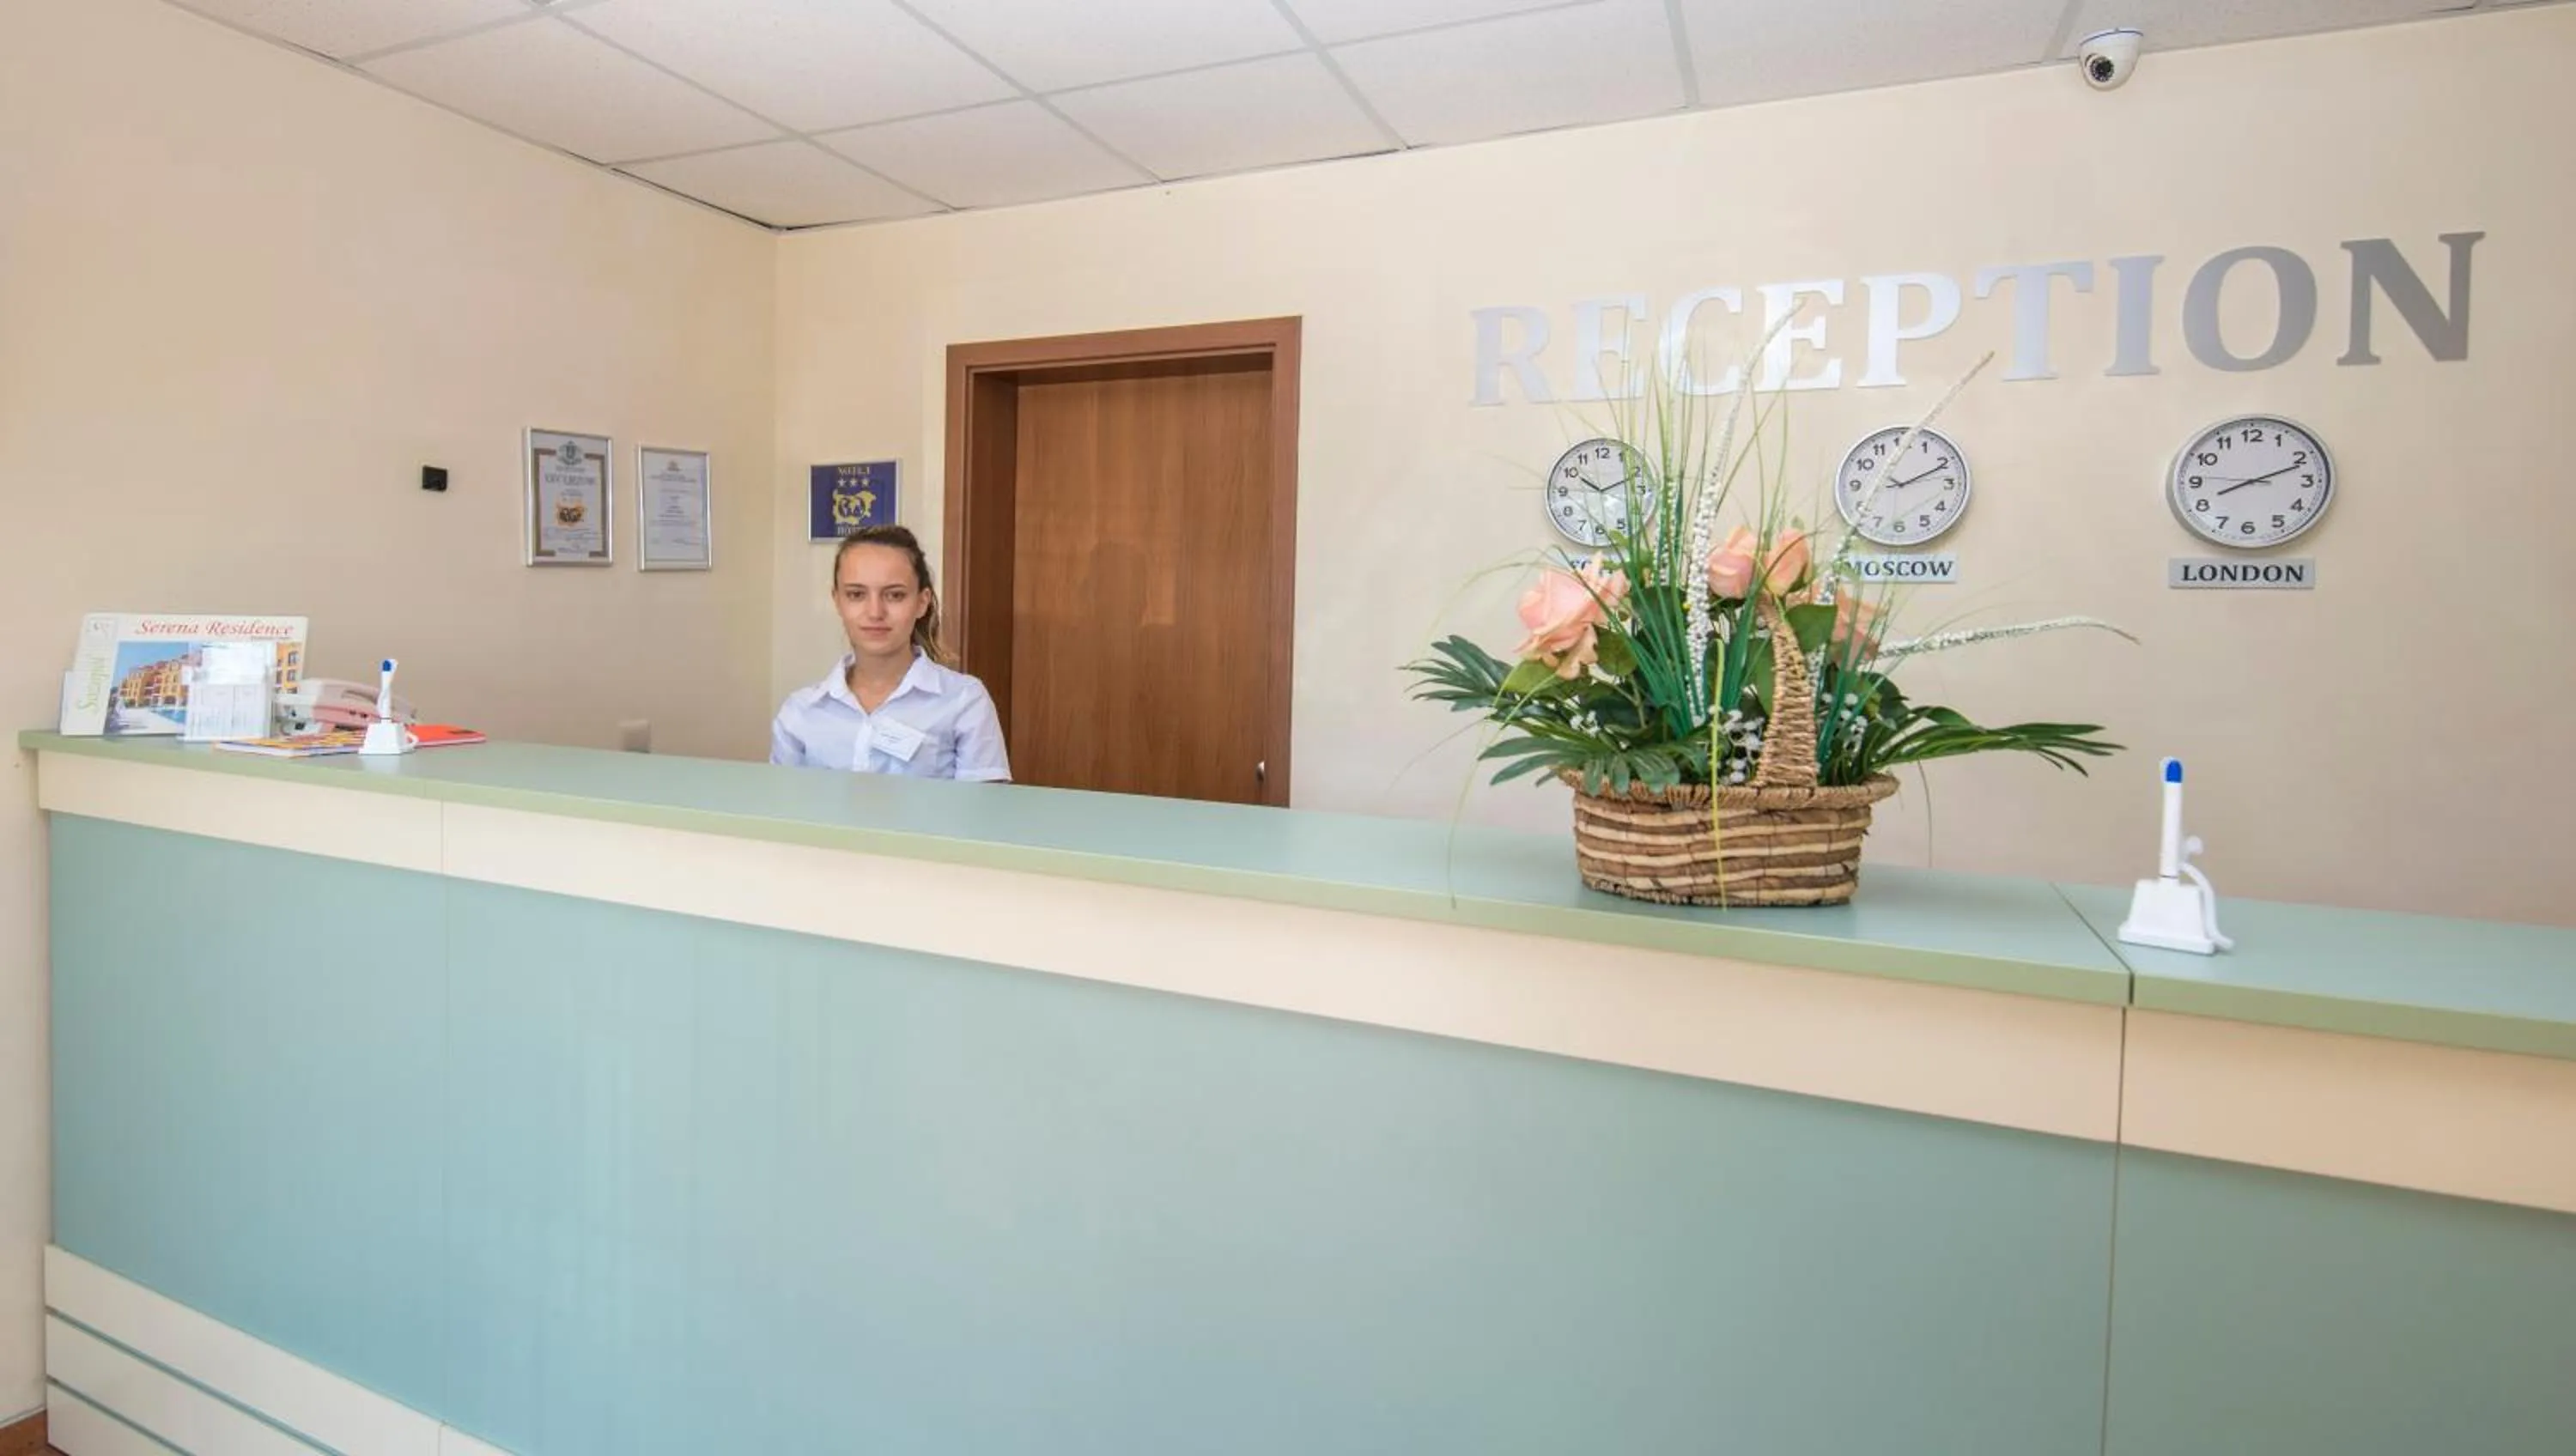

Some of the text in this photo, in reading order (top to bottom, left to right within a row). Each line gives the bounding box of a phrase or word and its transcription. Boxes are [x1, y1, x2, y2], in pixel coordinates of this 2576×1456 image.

[1467, 230, 2486, 407] RECEPTION
[2241, 429, 2263, 443] 12
[2275, 434, 2281, 447] 1
[1922, 441, 1928, 453] 1
[2216, 437, 2231, 450] 11
[1595, 447, 1610, 459] 12
[1873, 445, 1886, 456] 11
[1578, 453, 1588, 465] 11
[1856, 458, 1874, 470] 10
[1937, 457, 1948, 469] 2
[2197, 453, 2218, 466] 10
[2293, 452, 2306, 464] 2
[1564, 467, 1579, 478] 10
[1850, 480, 1862, 492] 9
[1943, 477, 1954, 490] 3
[2189, 476, 2202, 488] 9
[2300, 475, 2313, 488] 3
[1558, 486, 1568, 497] 9
[1637, 485, 1646, 495] 3
[1935, 500, 1946, 512] 4
[2196, 499, 2209, 512] 8
[2291, 498, 2304, 512] 4
[1563, 507, 1573, 517] 8
[1578, 520, 1587, 531] 7
[1617, 518, 1625, 530] 5
[1873, 516, 1882, 528] 7
[1893, 521, 1905, 533] 6
[1919, 515, 1930, 527] 5
[2215, 516, 2229, 529] 7
[2272, 515, 2285, 528] 5
[1595, 525, 1605, 535] 6
[2241, 521, 2256, 534] 6
[1845, 561, 1953, 577] MOSCOW
[2181, 564, 2305, 582] LONDON
[136, 619, 295, 637] Serena Residence
